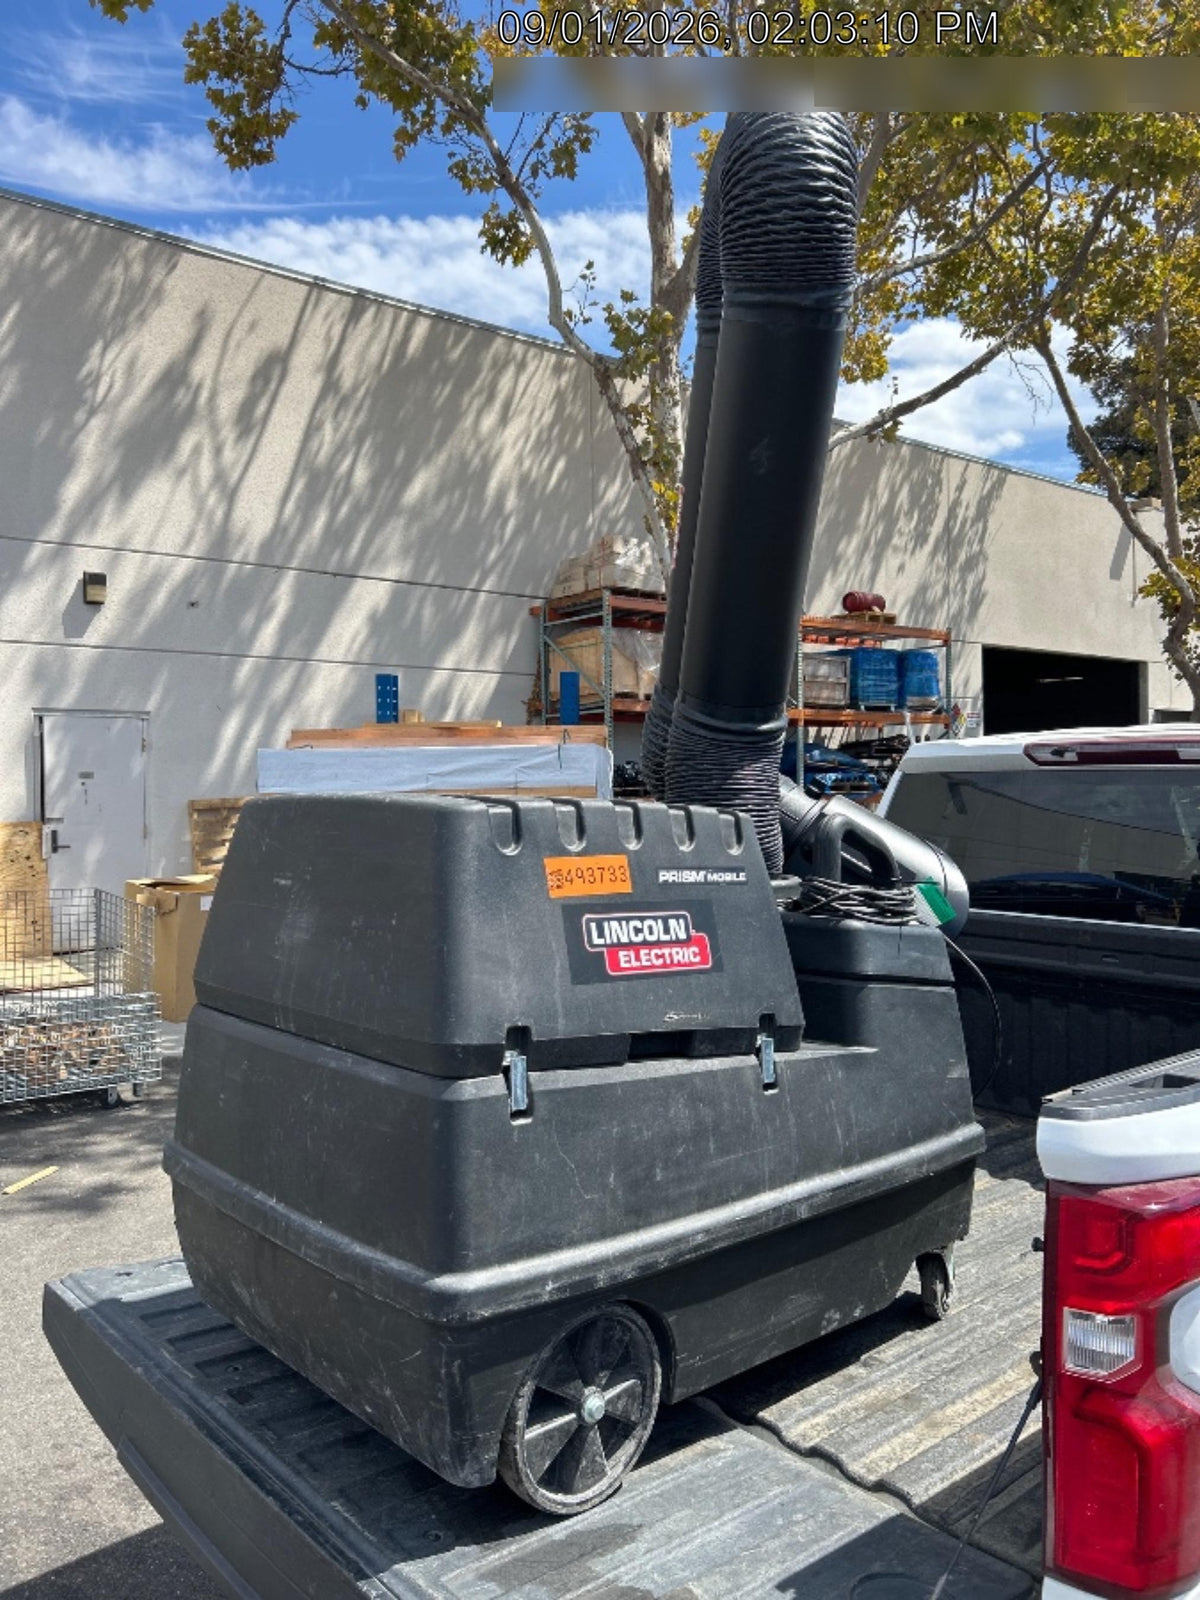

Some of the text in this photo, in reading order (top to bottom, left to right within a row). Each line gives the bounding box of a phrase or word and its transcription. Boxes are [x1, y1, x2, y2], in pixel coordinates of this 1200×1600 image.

[565, 865, 628, 885] 493733
[707, 872, 747, 882] MOBILE
[590, 918, 687, 945] LINCOLN
[618, 947, 702, 968] ELECTRIC
